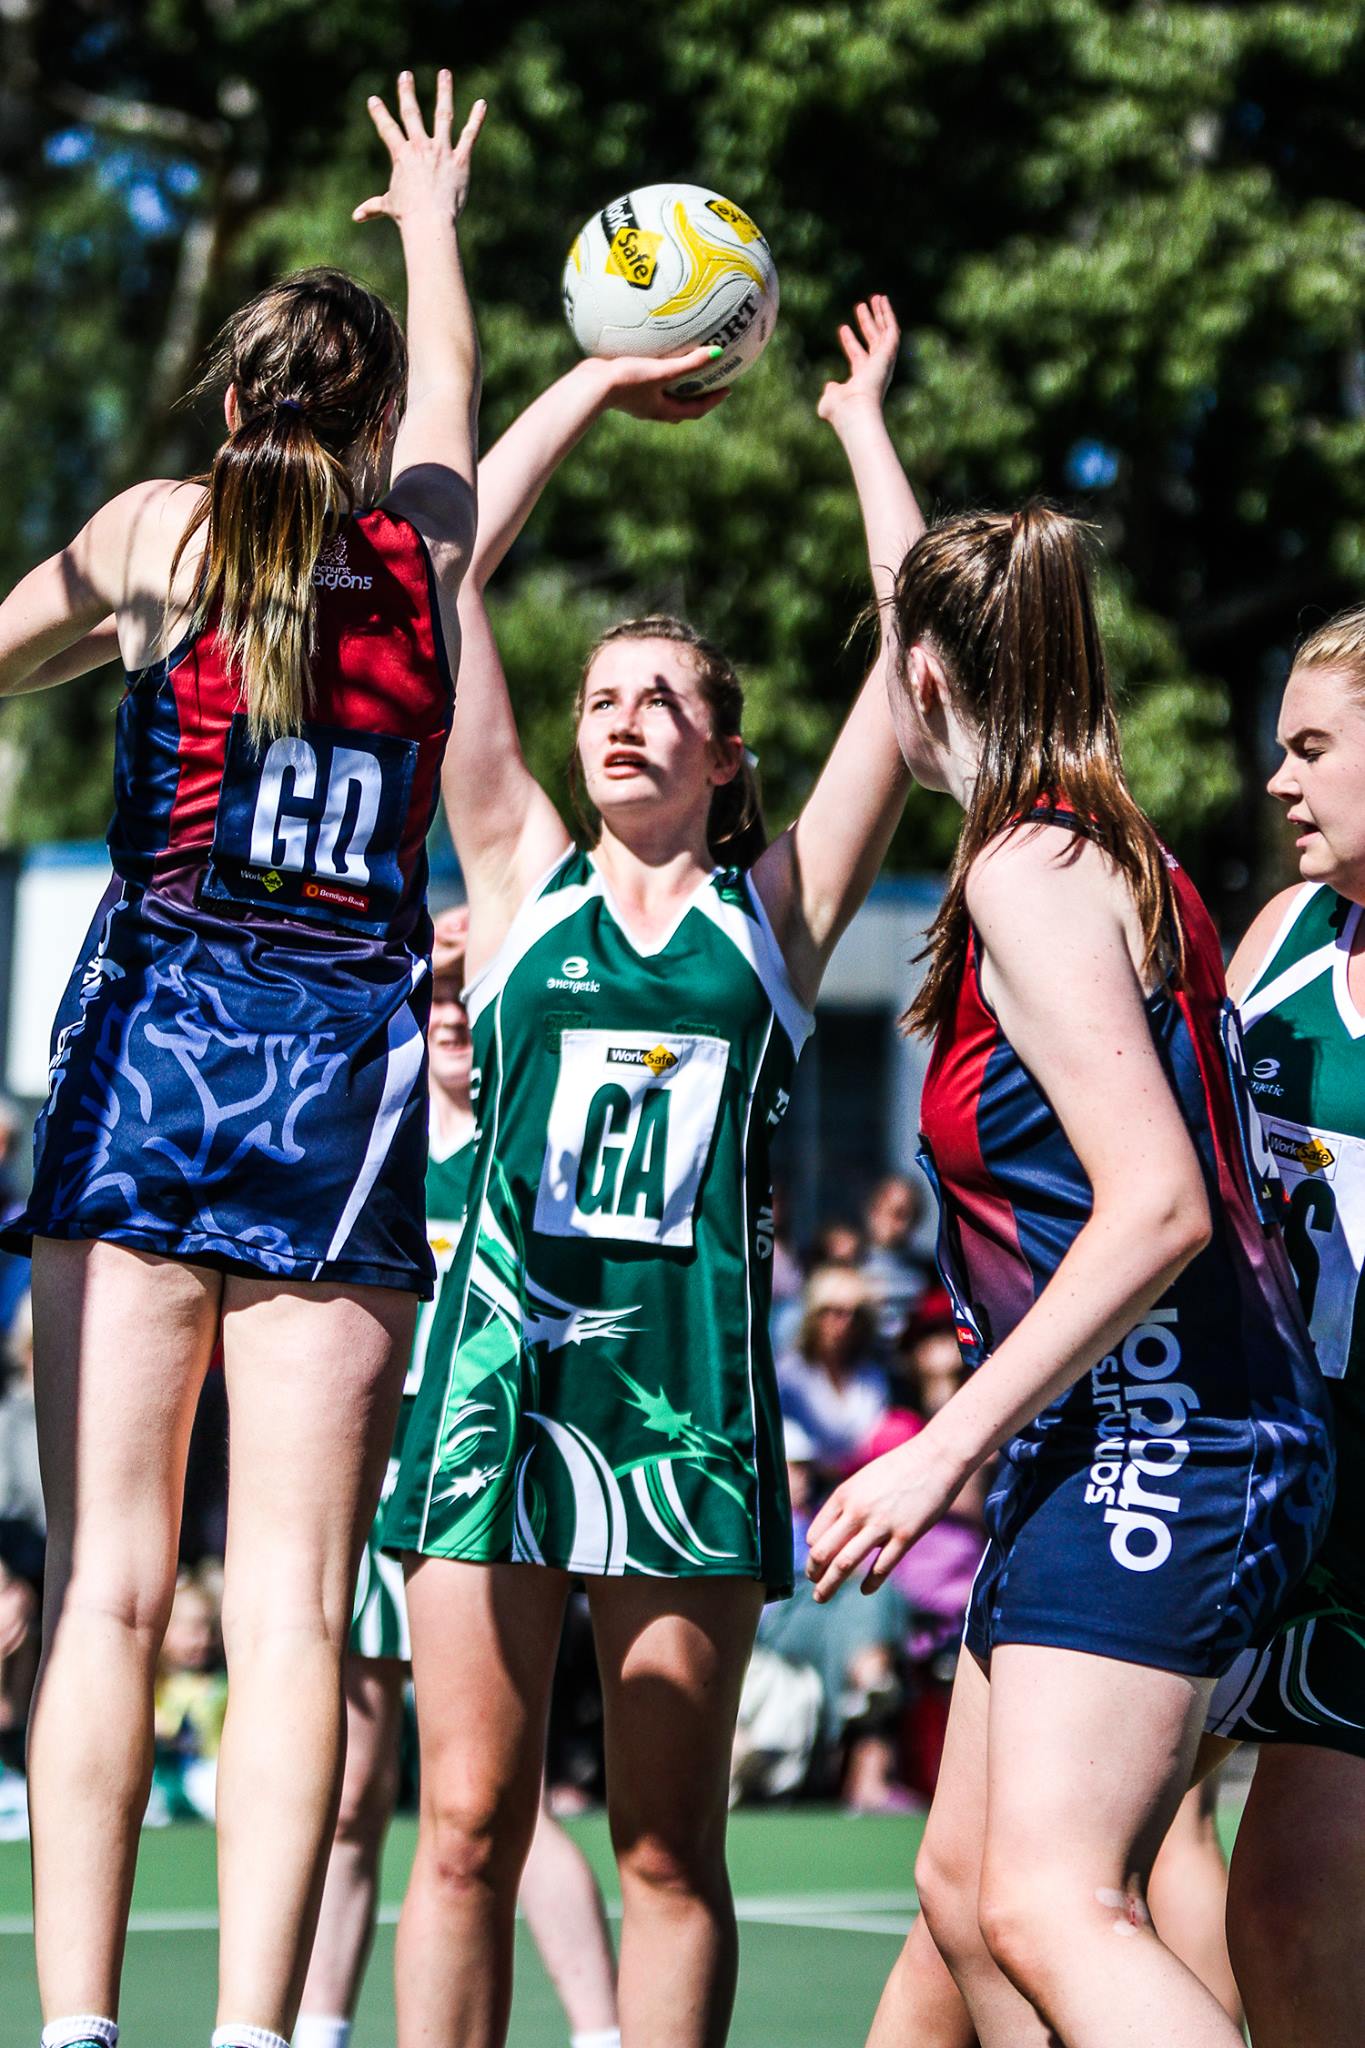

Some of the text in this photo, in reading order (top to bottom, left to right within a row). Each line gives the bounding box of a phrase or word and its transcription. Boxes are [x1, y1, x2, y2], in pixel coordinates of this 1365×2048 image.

[702, 296, 758, 349] ERT
[313, 573, 373, 591] agons
[248, 737, 382, 887] GD
[319, 889, 366, 908] Bendigo Bank
[575, 1083, 672, 1221] GA
